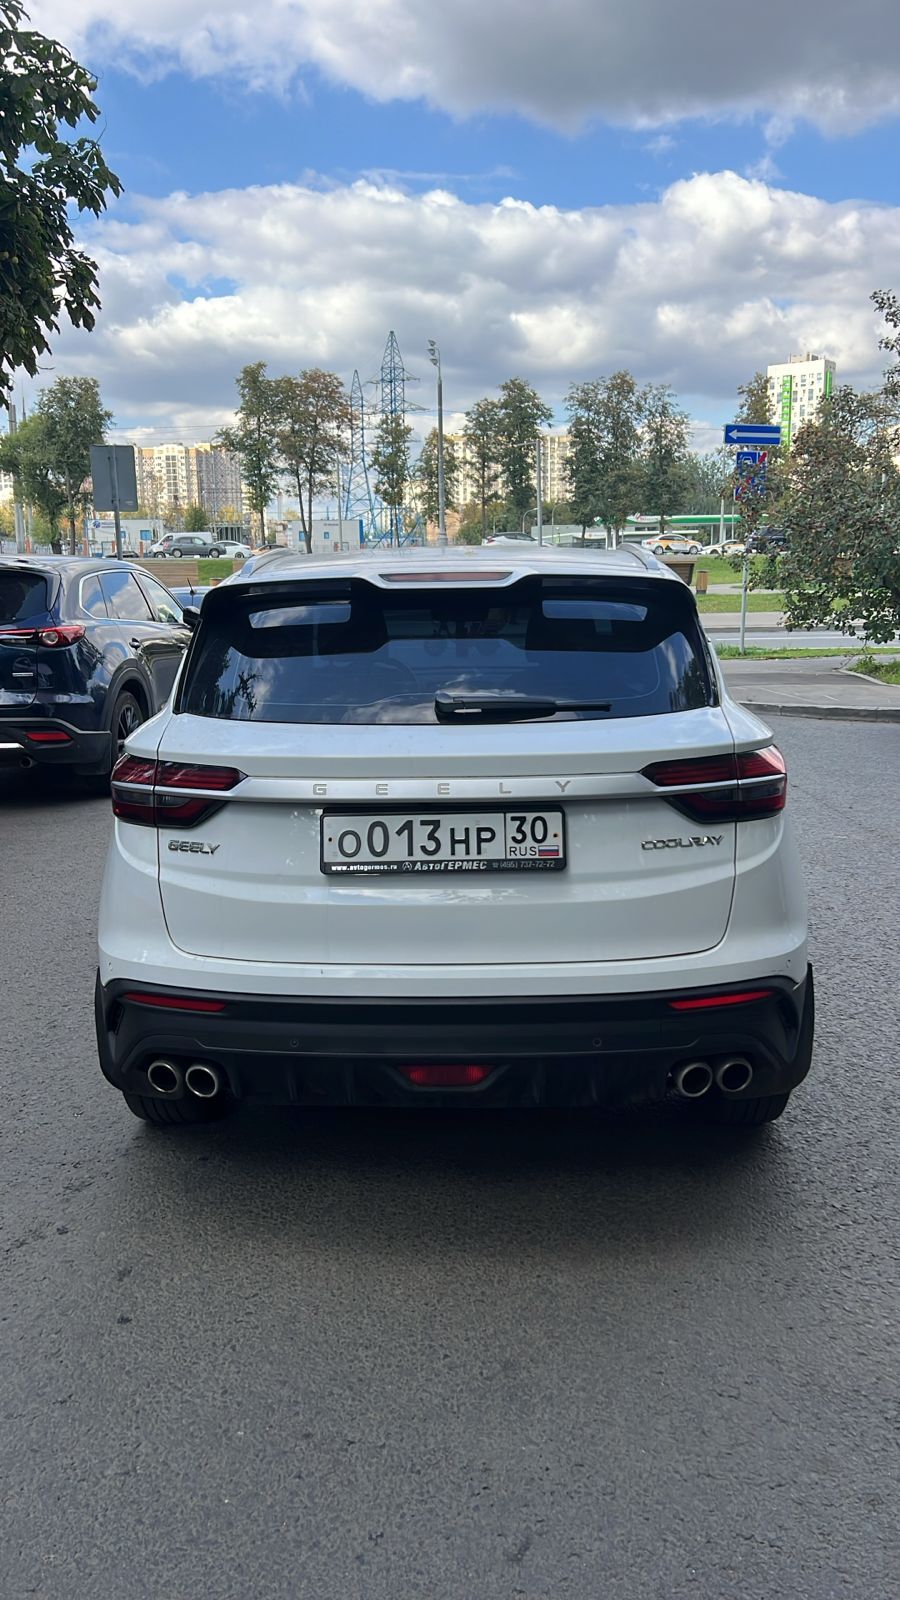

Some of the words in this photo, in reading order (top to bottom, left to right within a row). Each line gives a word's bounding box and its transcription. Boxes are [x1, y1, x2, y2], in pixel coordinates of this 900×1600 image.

[312, 780, 571, 796] GEELY
[510, 815, 548, 844] 30
[168, 840, 220, 855] GEELY
[641, 835, 724, 850] COOLRAY
[509, 846, 537, 857] RUS
